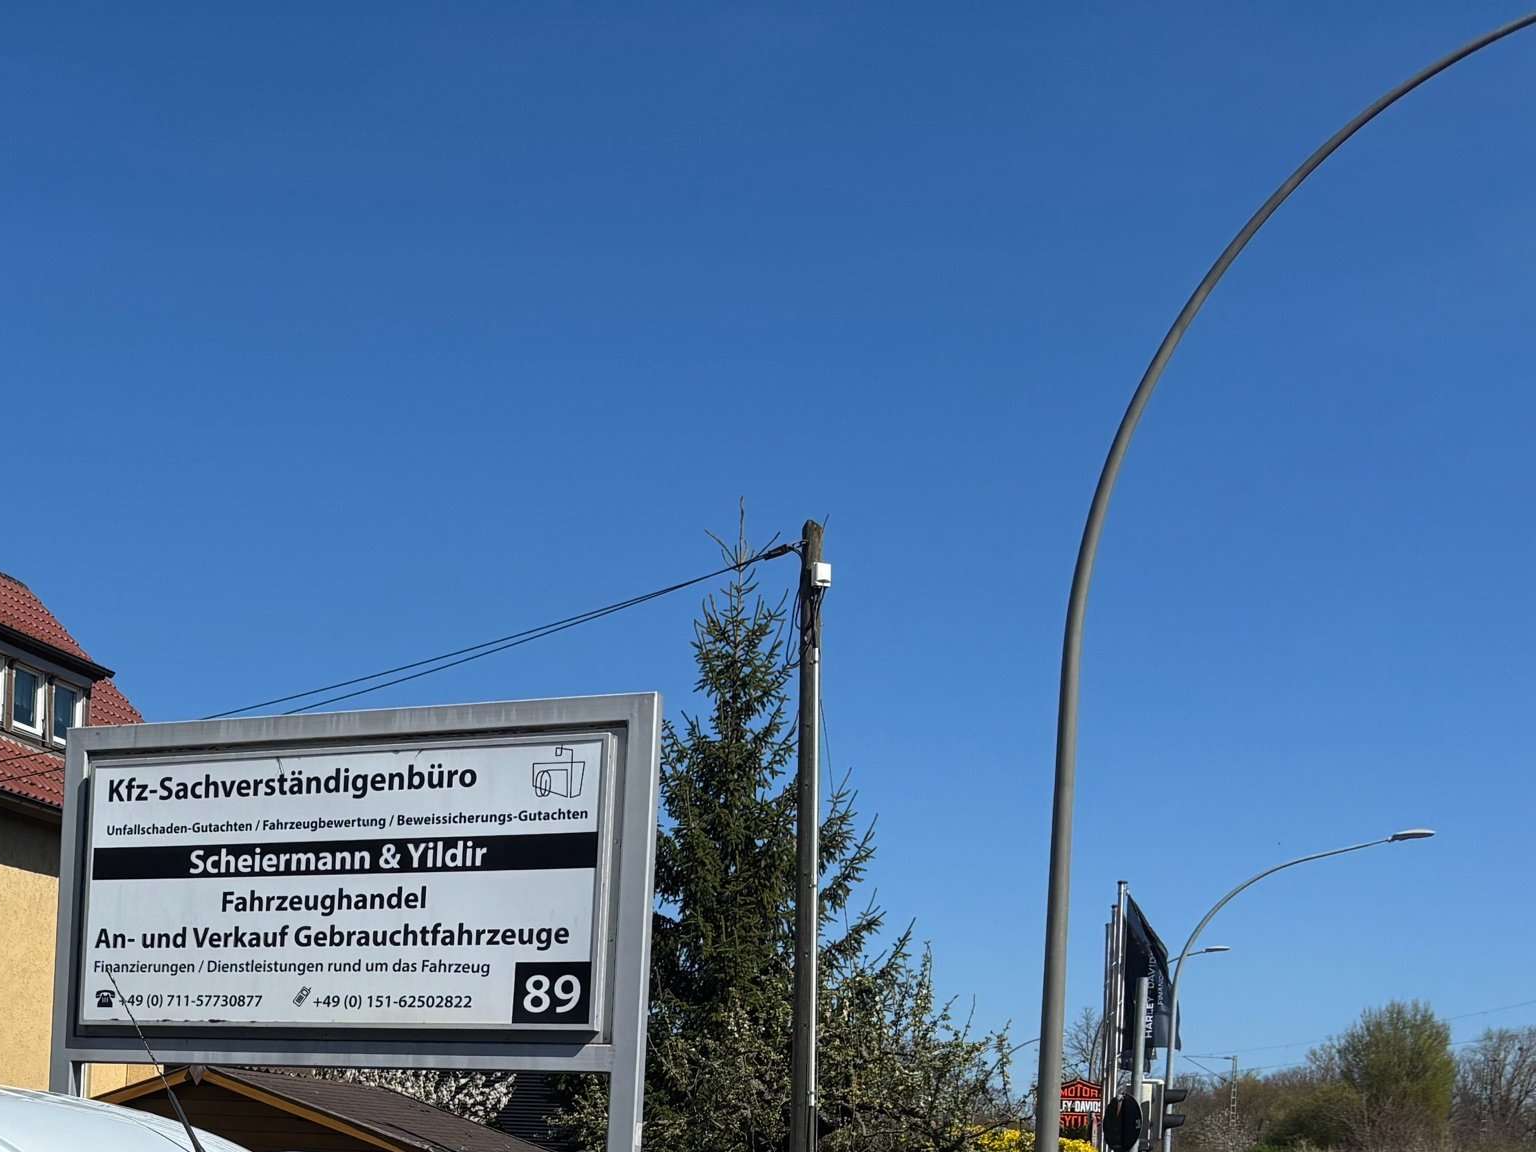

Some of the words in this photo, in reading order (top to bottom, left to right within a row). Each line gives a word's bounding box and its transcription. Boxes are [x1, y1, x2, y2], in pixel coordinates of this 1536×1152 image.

[108, 764, 477, 802] Kfz-Sachverständigenbüro
[106, 820, 252, 836] Unfallschaden-Gutachten
[263, 815, 386, 832] Fahrzeugbewertung
[397, 808, 588, 826] Beweissicherungs-Gutachten
[189, 847, 371, 874] Scheiermann
[378, 843, 401, 870] &
[407, 840, 487, 868] Yildir
[221, 886, 427, 916] Fahrzeughandel
[94, 927, 135, 948] An-
[141, 926, 187, 949] und
[193, 924, 289, 948] Verkauf
[294, 922, 570, 951] Gebrauchtfahrzeuge
[93, 960, 195, 976] Finanzierungen
[207, 959, 324, 976] Dienstleistungen
[327, 958, 361, 973] rund
[366, 962, 388, 973] um
[392, 958, 417, 973] das
[421, 959, 491, 977] Fahrzeug
[119, 994, 143, 1007] +49
[146, 993, 163, 1009] (0)
[167, 994, 263, 1007] 711-57730877
[313, 995, 340, 1008] +49
[344, 994, 362, 1010] (0)
[367, 995, 472, 1008] 151-62502822
[523, 974, 581, 1014] 89
